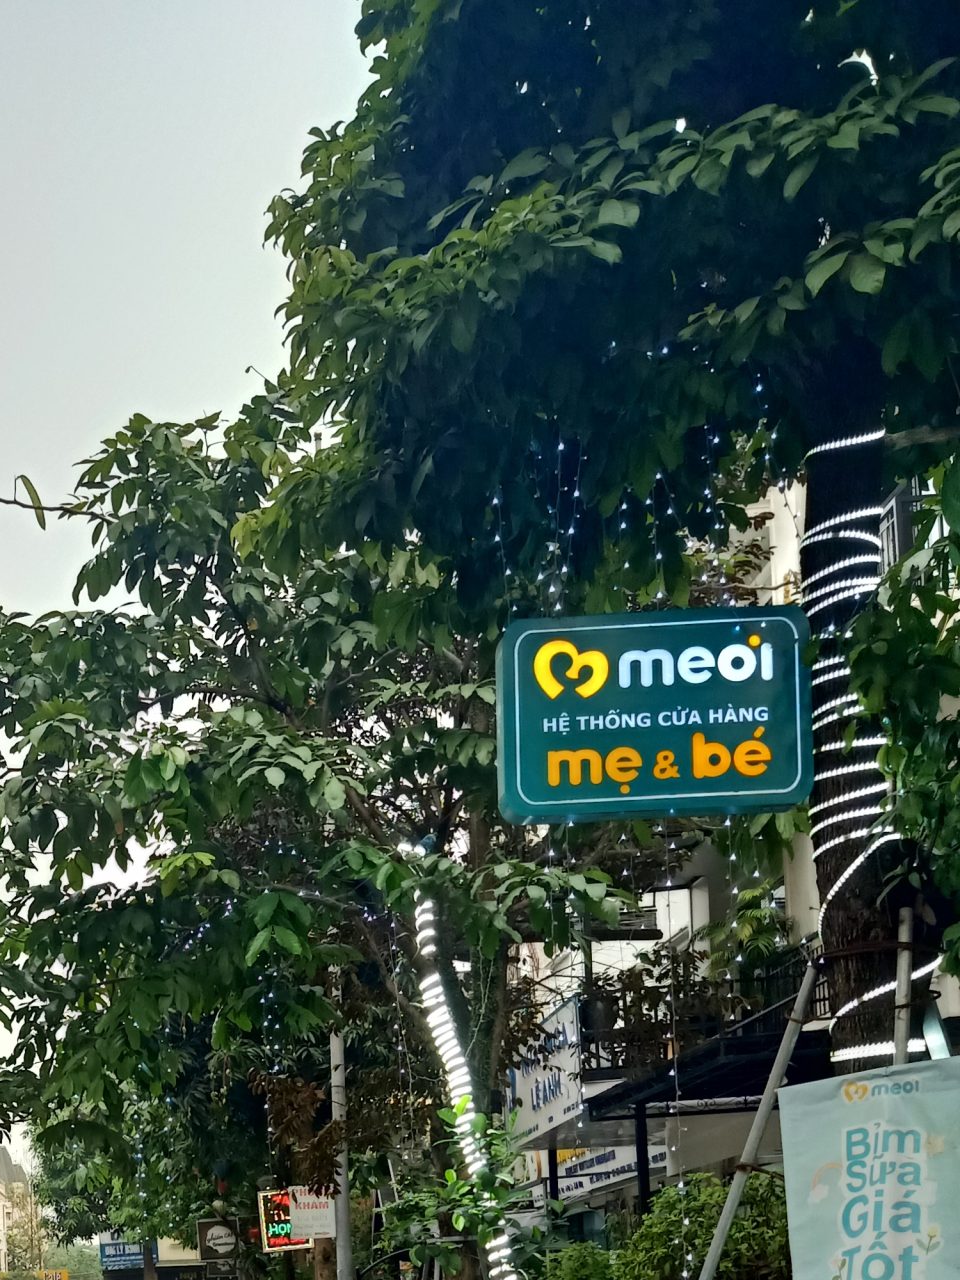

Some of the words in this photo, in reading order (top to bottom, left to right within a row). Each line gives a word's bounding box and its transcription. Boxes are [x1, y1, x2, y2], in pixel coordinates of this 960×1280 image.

[618, 634, 774, 689] meoi
[543, 712, 571, 735] HỆ
[576, 708, 652, 731] THỐNG
[658, 704, 702, 727] CỬA
[708, 702, 769, 725] HÀNG
[547, 746, 643, 795] mẹ
[652, 749, 681, 780] &
[691, 726, 772, 779] bé
[846, 1122, 921, 1160] Bỉm
[846, 1153, 921, 1193] Sữa
[842, 1189, 921, 1238] Giá
